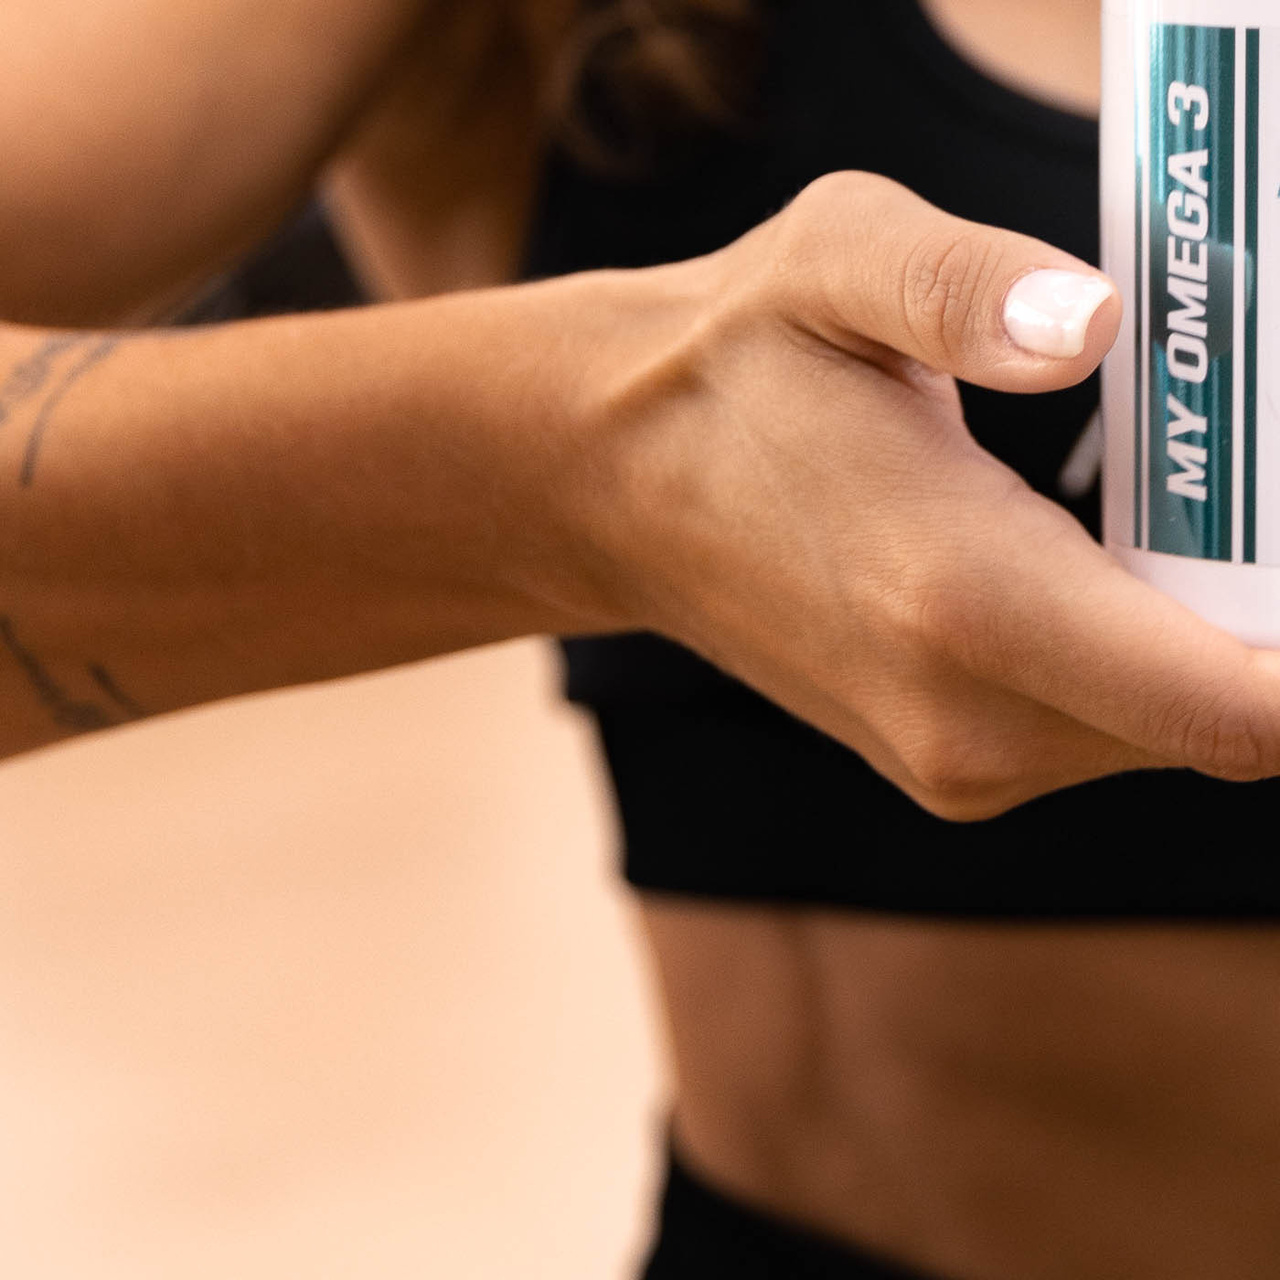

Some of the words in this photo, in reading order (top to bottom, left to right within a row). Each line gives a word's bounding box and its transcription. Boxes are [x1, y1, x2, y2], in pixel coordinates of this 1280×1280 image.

[1167, 80, 1209, 130] 3
[1167, 149, 1209, 383] OMEGA
[1167, 395, 1208, 501] MY
